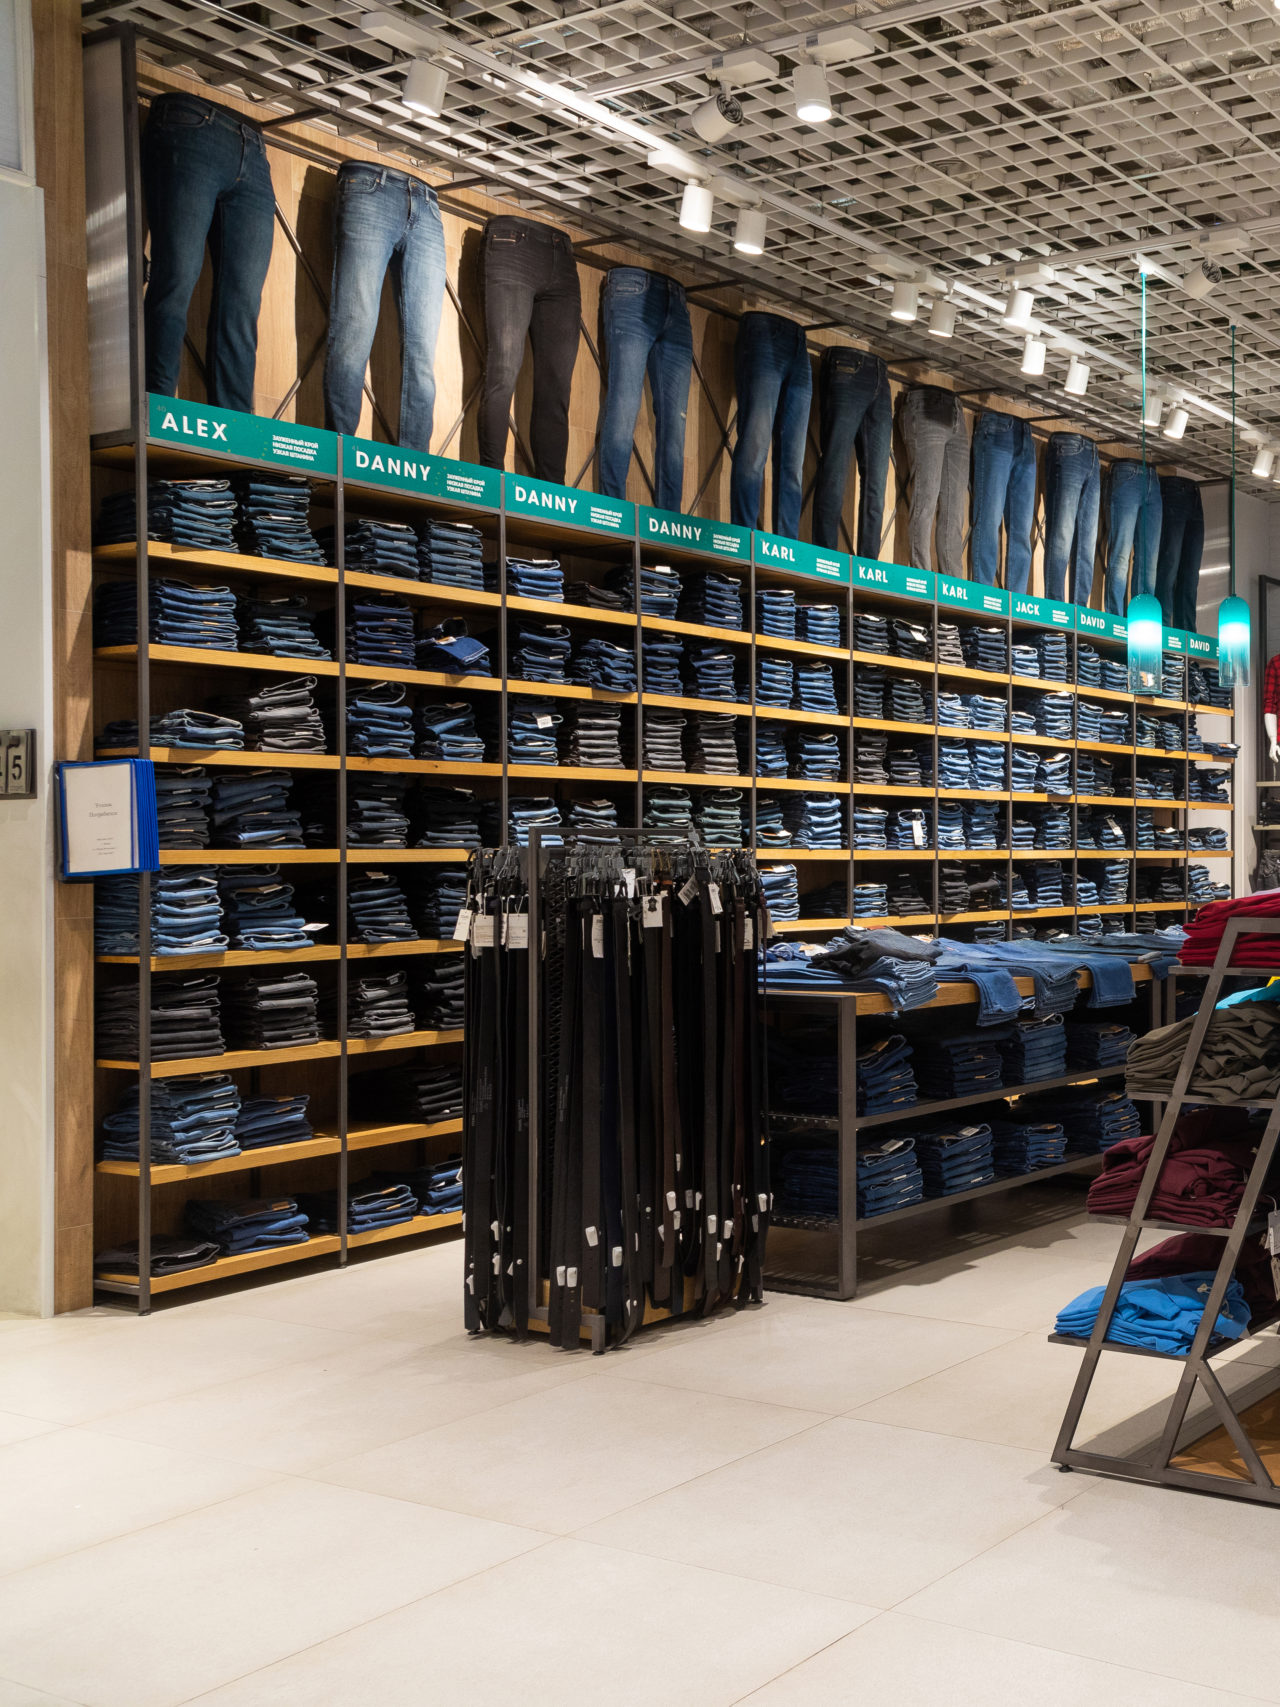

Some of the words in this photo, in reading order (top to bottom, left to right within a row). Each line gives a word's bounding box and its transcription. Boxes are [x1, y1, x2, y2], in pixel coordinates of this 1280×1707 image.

[161, 412, 228, 442] ALEX
[356, 450, 431, 481] DANNY
[515, 485, 578, 514] DANNY
[649, 517, 702, 541] DANNY
[762, 540, 796, 562] KARL
[859, 566, 888, 584] KARL
[942, 583, 969, 600] KARL
[1016, 601, 1040, 616] JACK
[1080, 613, 1106, 630] DAVID
[1189, 638, 1210, 652] DAVID
